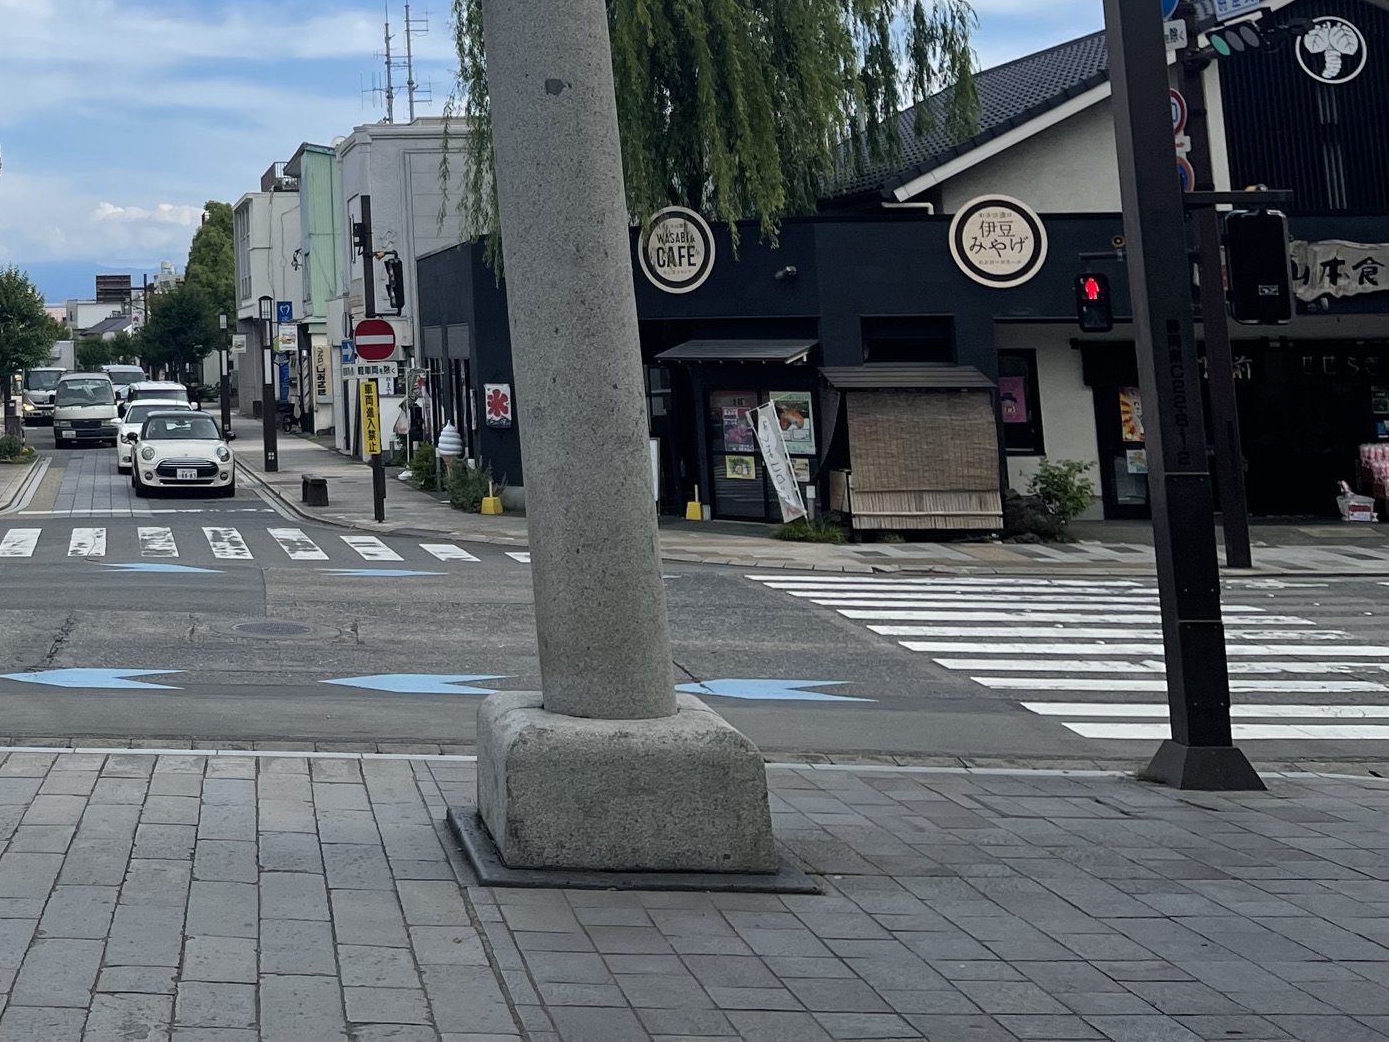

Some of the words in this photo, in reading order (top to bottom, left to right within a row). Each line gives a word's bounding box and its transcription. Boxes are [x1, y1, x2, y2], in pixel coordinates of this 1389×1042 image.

[979, 220, 1015, 238] 伊豆
[656, 245, 696, 268] CAFE
[969, 236, 1029, 258] みやげ
[357, 365, 396, 375] 軽車両を除く
[487, 389, 509, 418] 氷
[364, 384, 377, 453] 車両進入禁止
